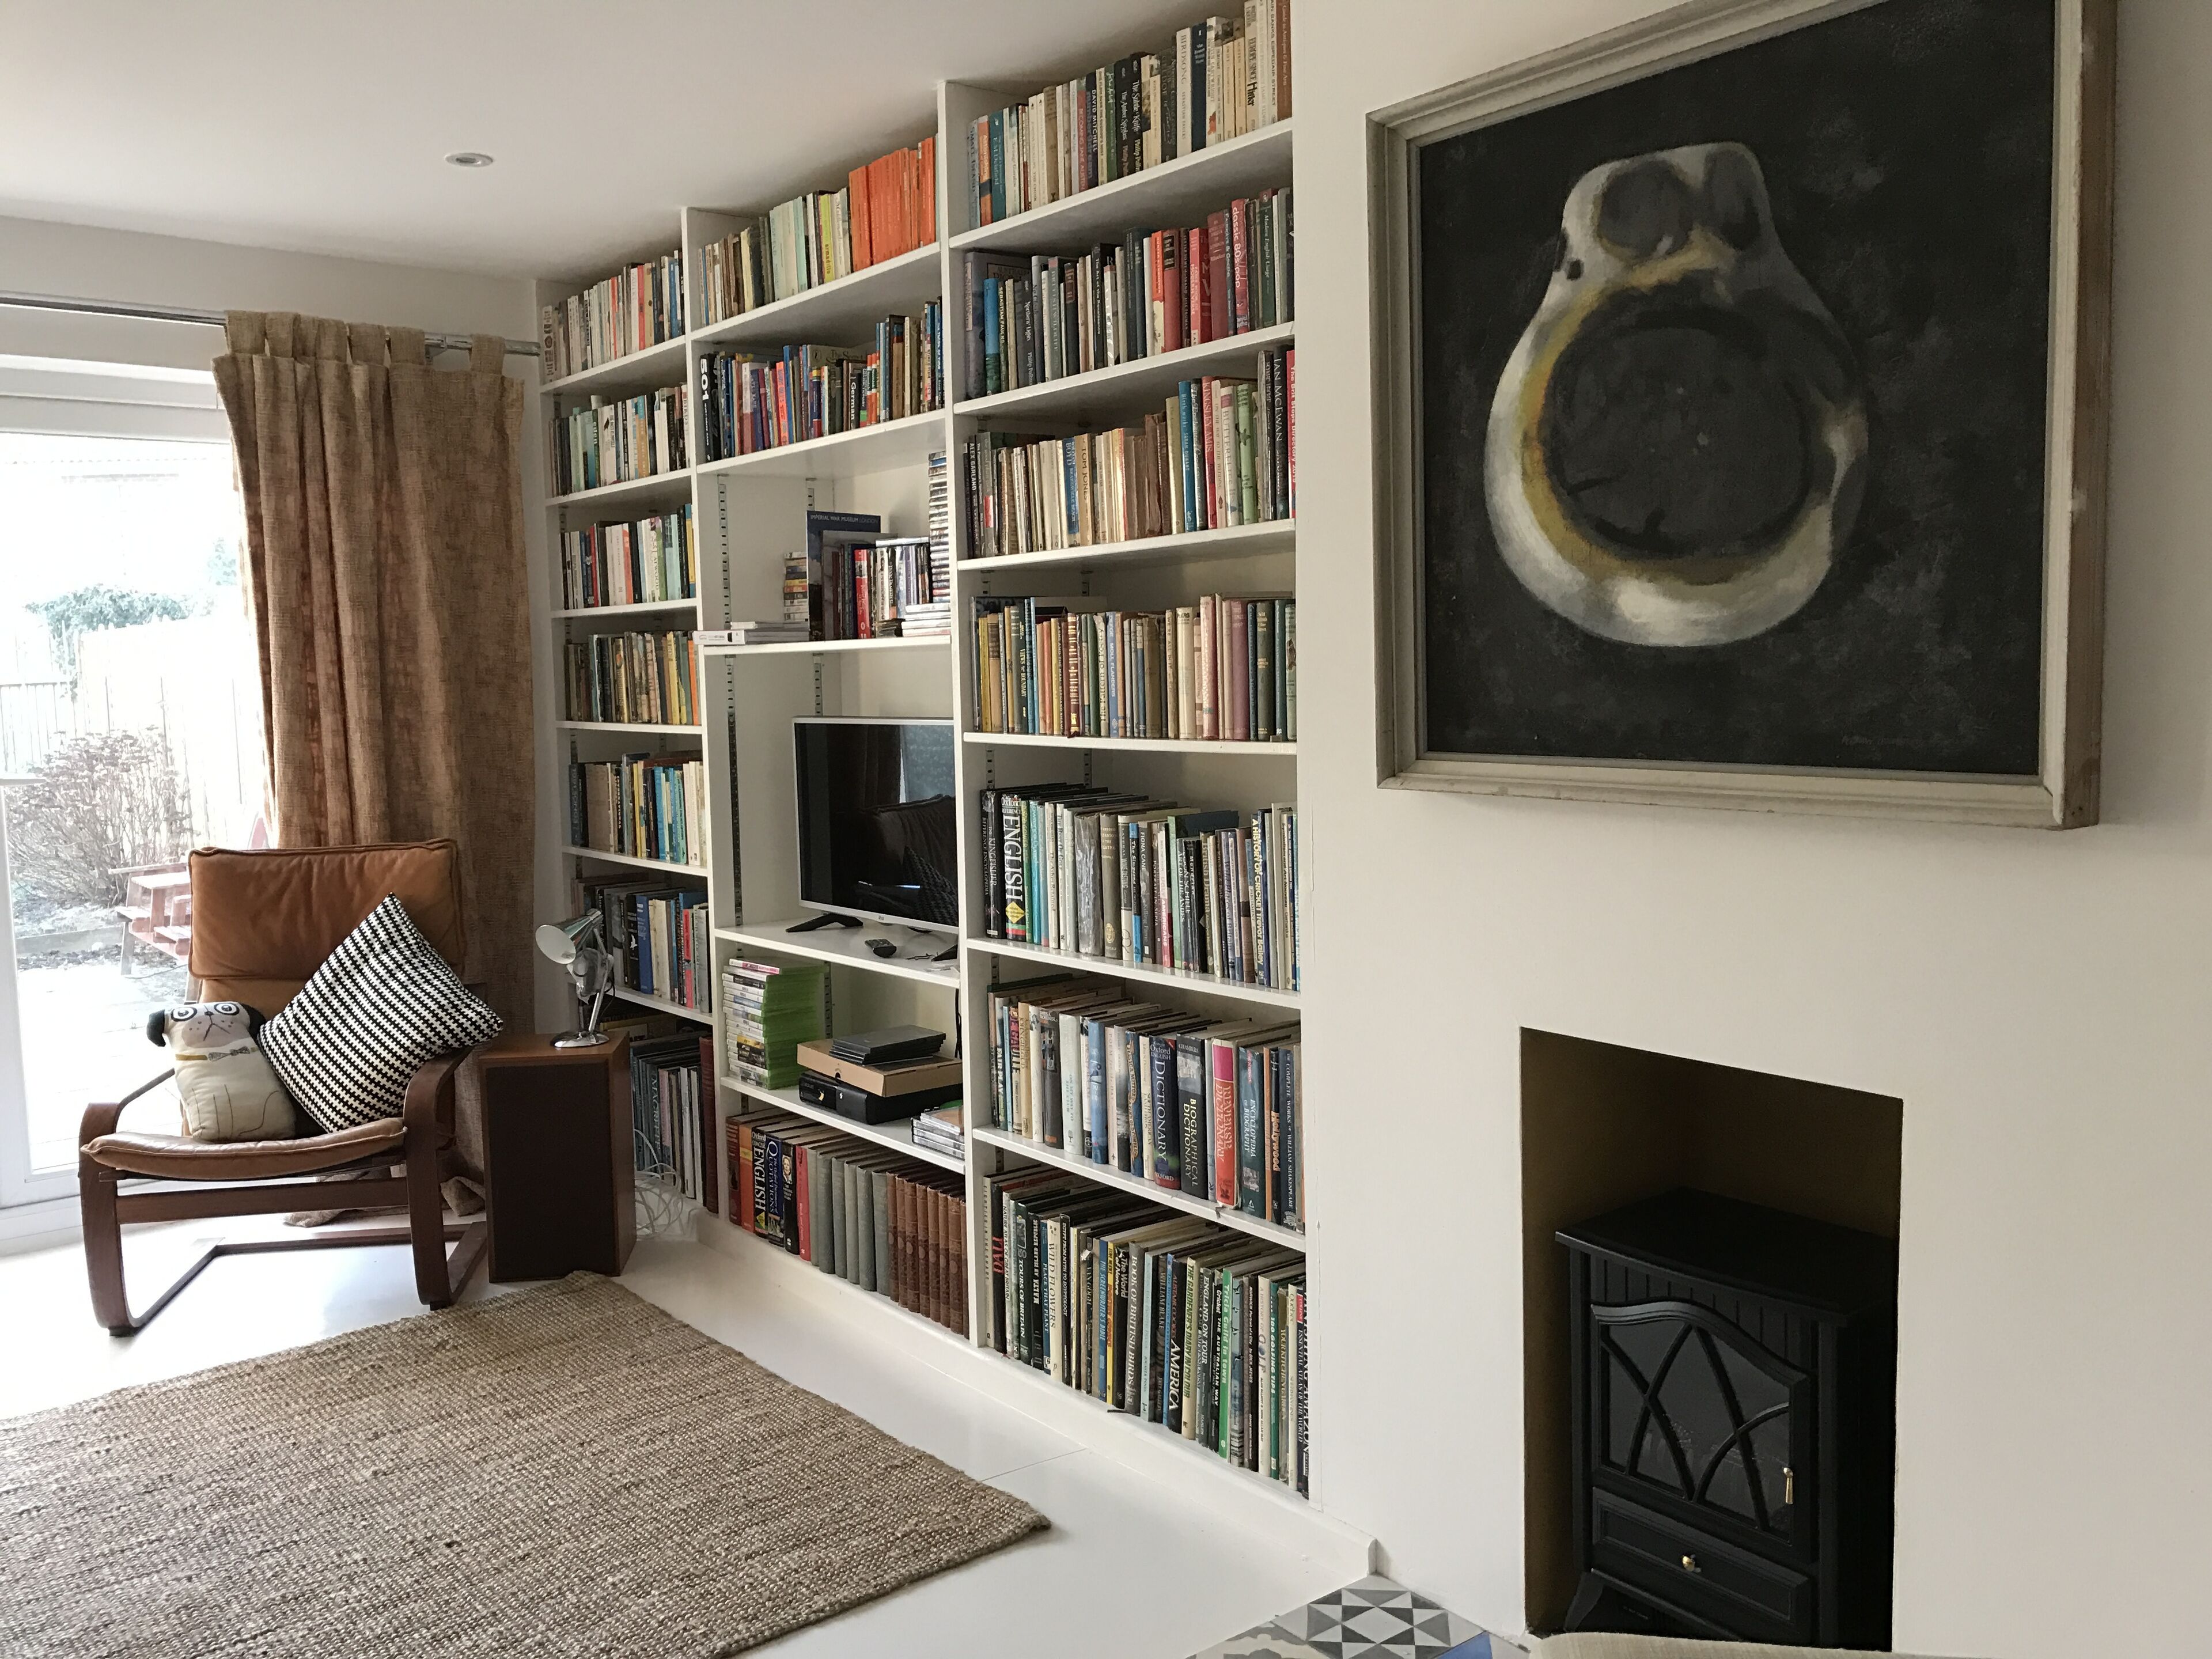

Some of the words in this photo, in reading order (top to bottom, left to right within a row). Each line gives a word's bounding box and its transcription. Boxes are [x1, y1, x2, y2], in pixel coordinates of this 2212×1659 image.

[1247, 81, 1257, 106] Hitler
[1132, 115, 1140, 132] Knife
[700, 358, 709, 401] 501
[1274, 358, 1282, 381] IAN
[1203, 382, 1211, 429] KINGSLEY
[1001, 797, 1021, 806] Oxford
[1003, 815, 1023, 902] ENGLISH
[1252, 827, 1260, 861] HISTORY
[988, 838, 997, 886] KINGFISHER
[1254, 862, 1261, 874] OF
[1150, 1044, 1171, 1055] Oxford
[1155, 1060, 1167, 1161] DICTIONARY
[1215, 1082, 1225, 1162] DICTIONARY
[1224, 1086, 1232, 1149] REVERSE
[1183, 1103, 1192, 1177] DICTIONARY
[1190, 1098, 1198, 1187] BIOGRAPHICAL
[1270, 1111, 1281, 1172] Hollywood
[753, 1147, 766, 1211] ENGLISH
[1115, 1257, 1120, 1266] of
[1185, 1266, 1194, 1280] THE
[1019, 1289, 1025, 1302] OF
[1130, 1289, 1137, 1302] OF
[1185, 1280, 1194, 1332] GARDENER'S
[1201, 1275, 1209, 1321] ENGLAND
[1128, 1304, 1137, 1350] BRITISH
[1201, 1324, 1209, 1338] ON
[1184, 1332, 1193, 1359] DIARY
[1200, 1340, 1209, 1364] TOUR
[1127, 1351, 1135, 1385] BIRDS
[1169, 1339, 1181, 1410] AMERICA
[1184, 1366, 1192, 1399] COLOUR
